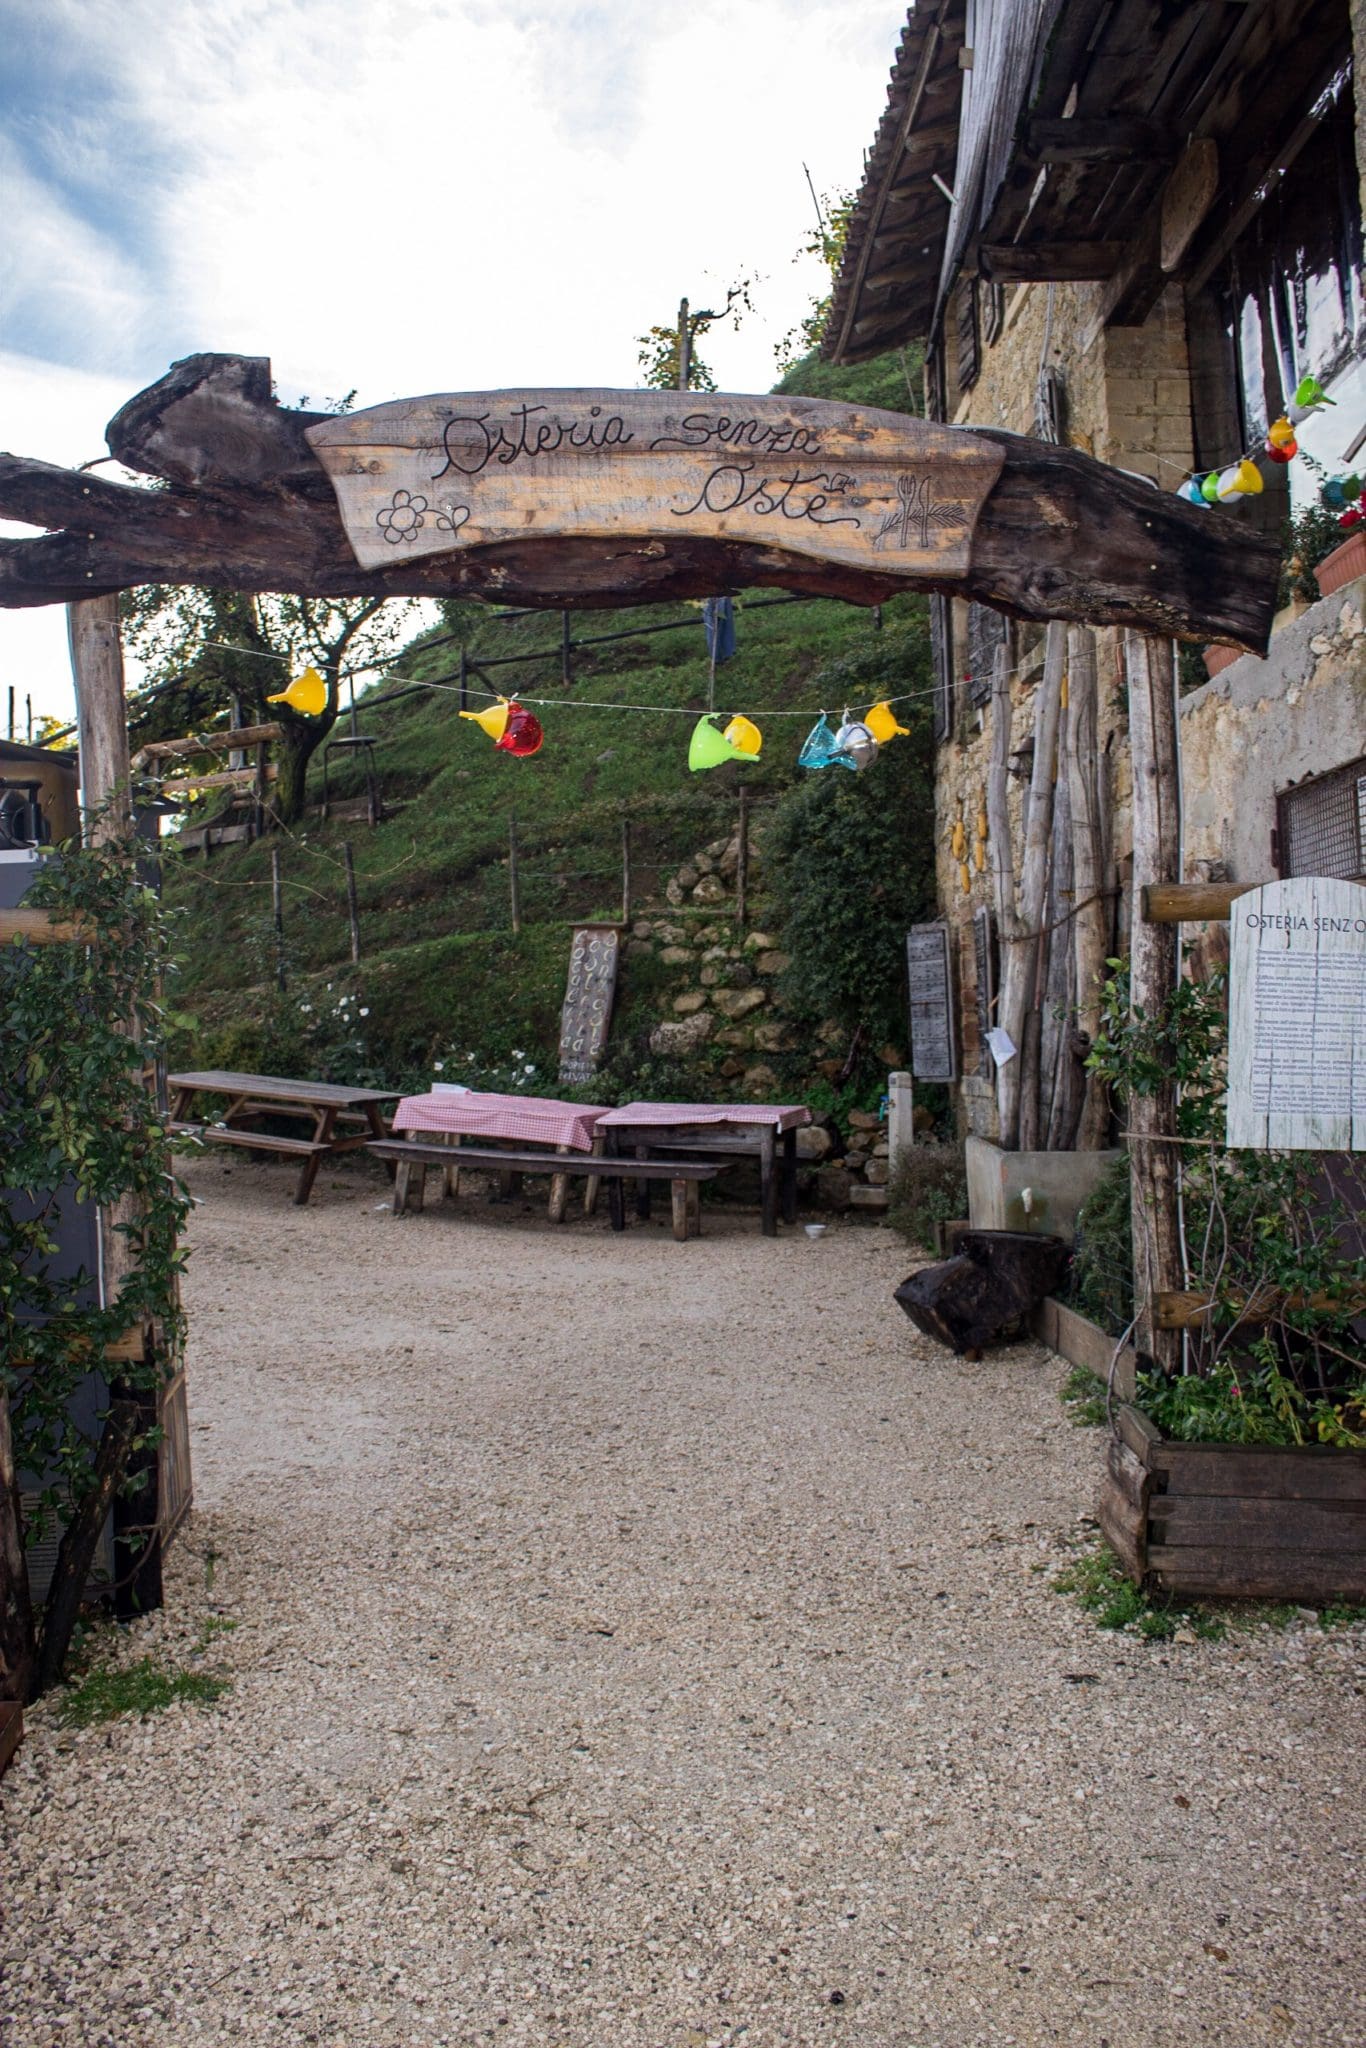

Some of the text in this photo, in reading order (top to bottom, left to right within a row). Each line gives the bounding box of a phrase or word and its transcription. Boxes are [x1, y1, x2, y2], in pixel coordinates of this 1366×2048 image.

[431, 404, 634, 480] Osteria
[671, 462, 861, 528] Oste
[1246, 914, 1309, 930] OSTERIA
